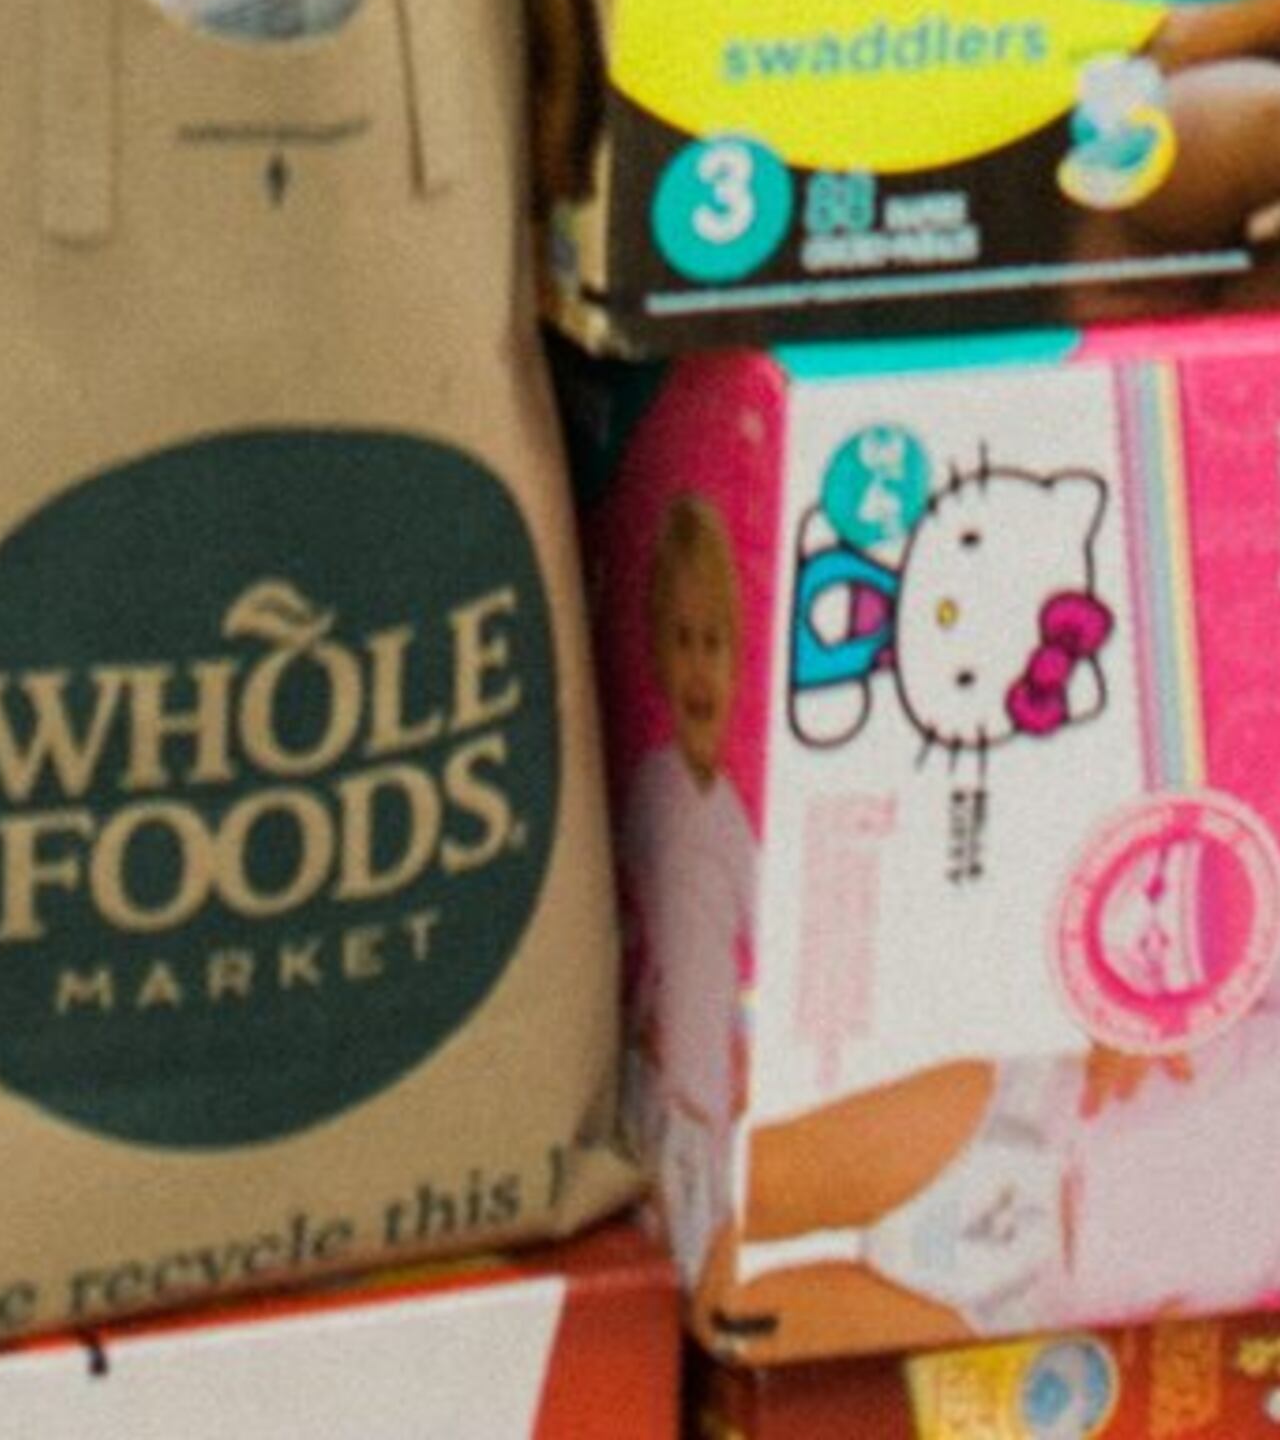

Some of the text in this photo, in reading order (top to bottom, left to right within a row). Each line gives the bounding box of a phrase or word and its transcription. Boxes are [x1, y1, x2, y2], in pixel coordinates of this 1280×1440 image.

[721, 13, 1048, 80] swaddlers
[691, 142, 757, 244] 3
[56, 910, 440, 1014] MARKET
[67, 1214, 357, 1320] recycle
[384, 1170, 521, 1246] this
